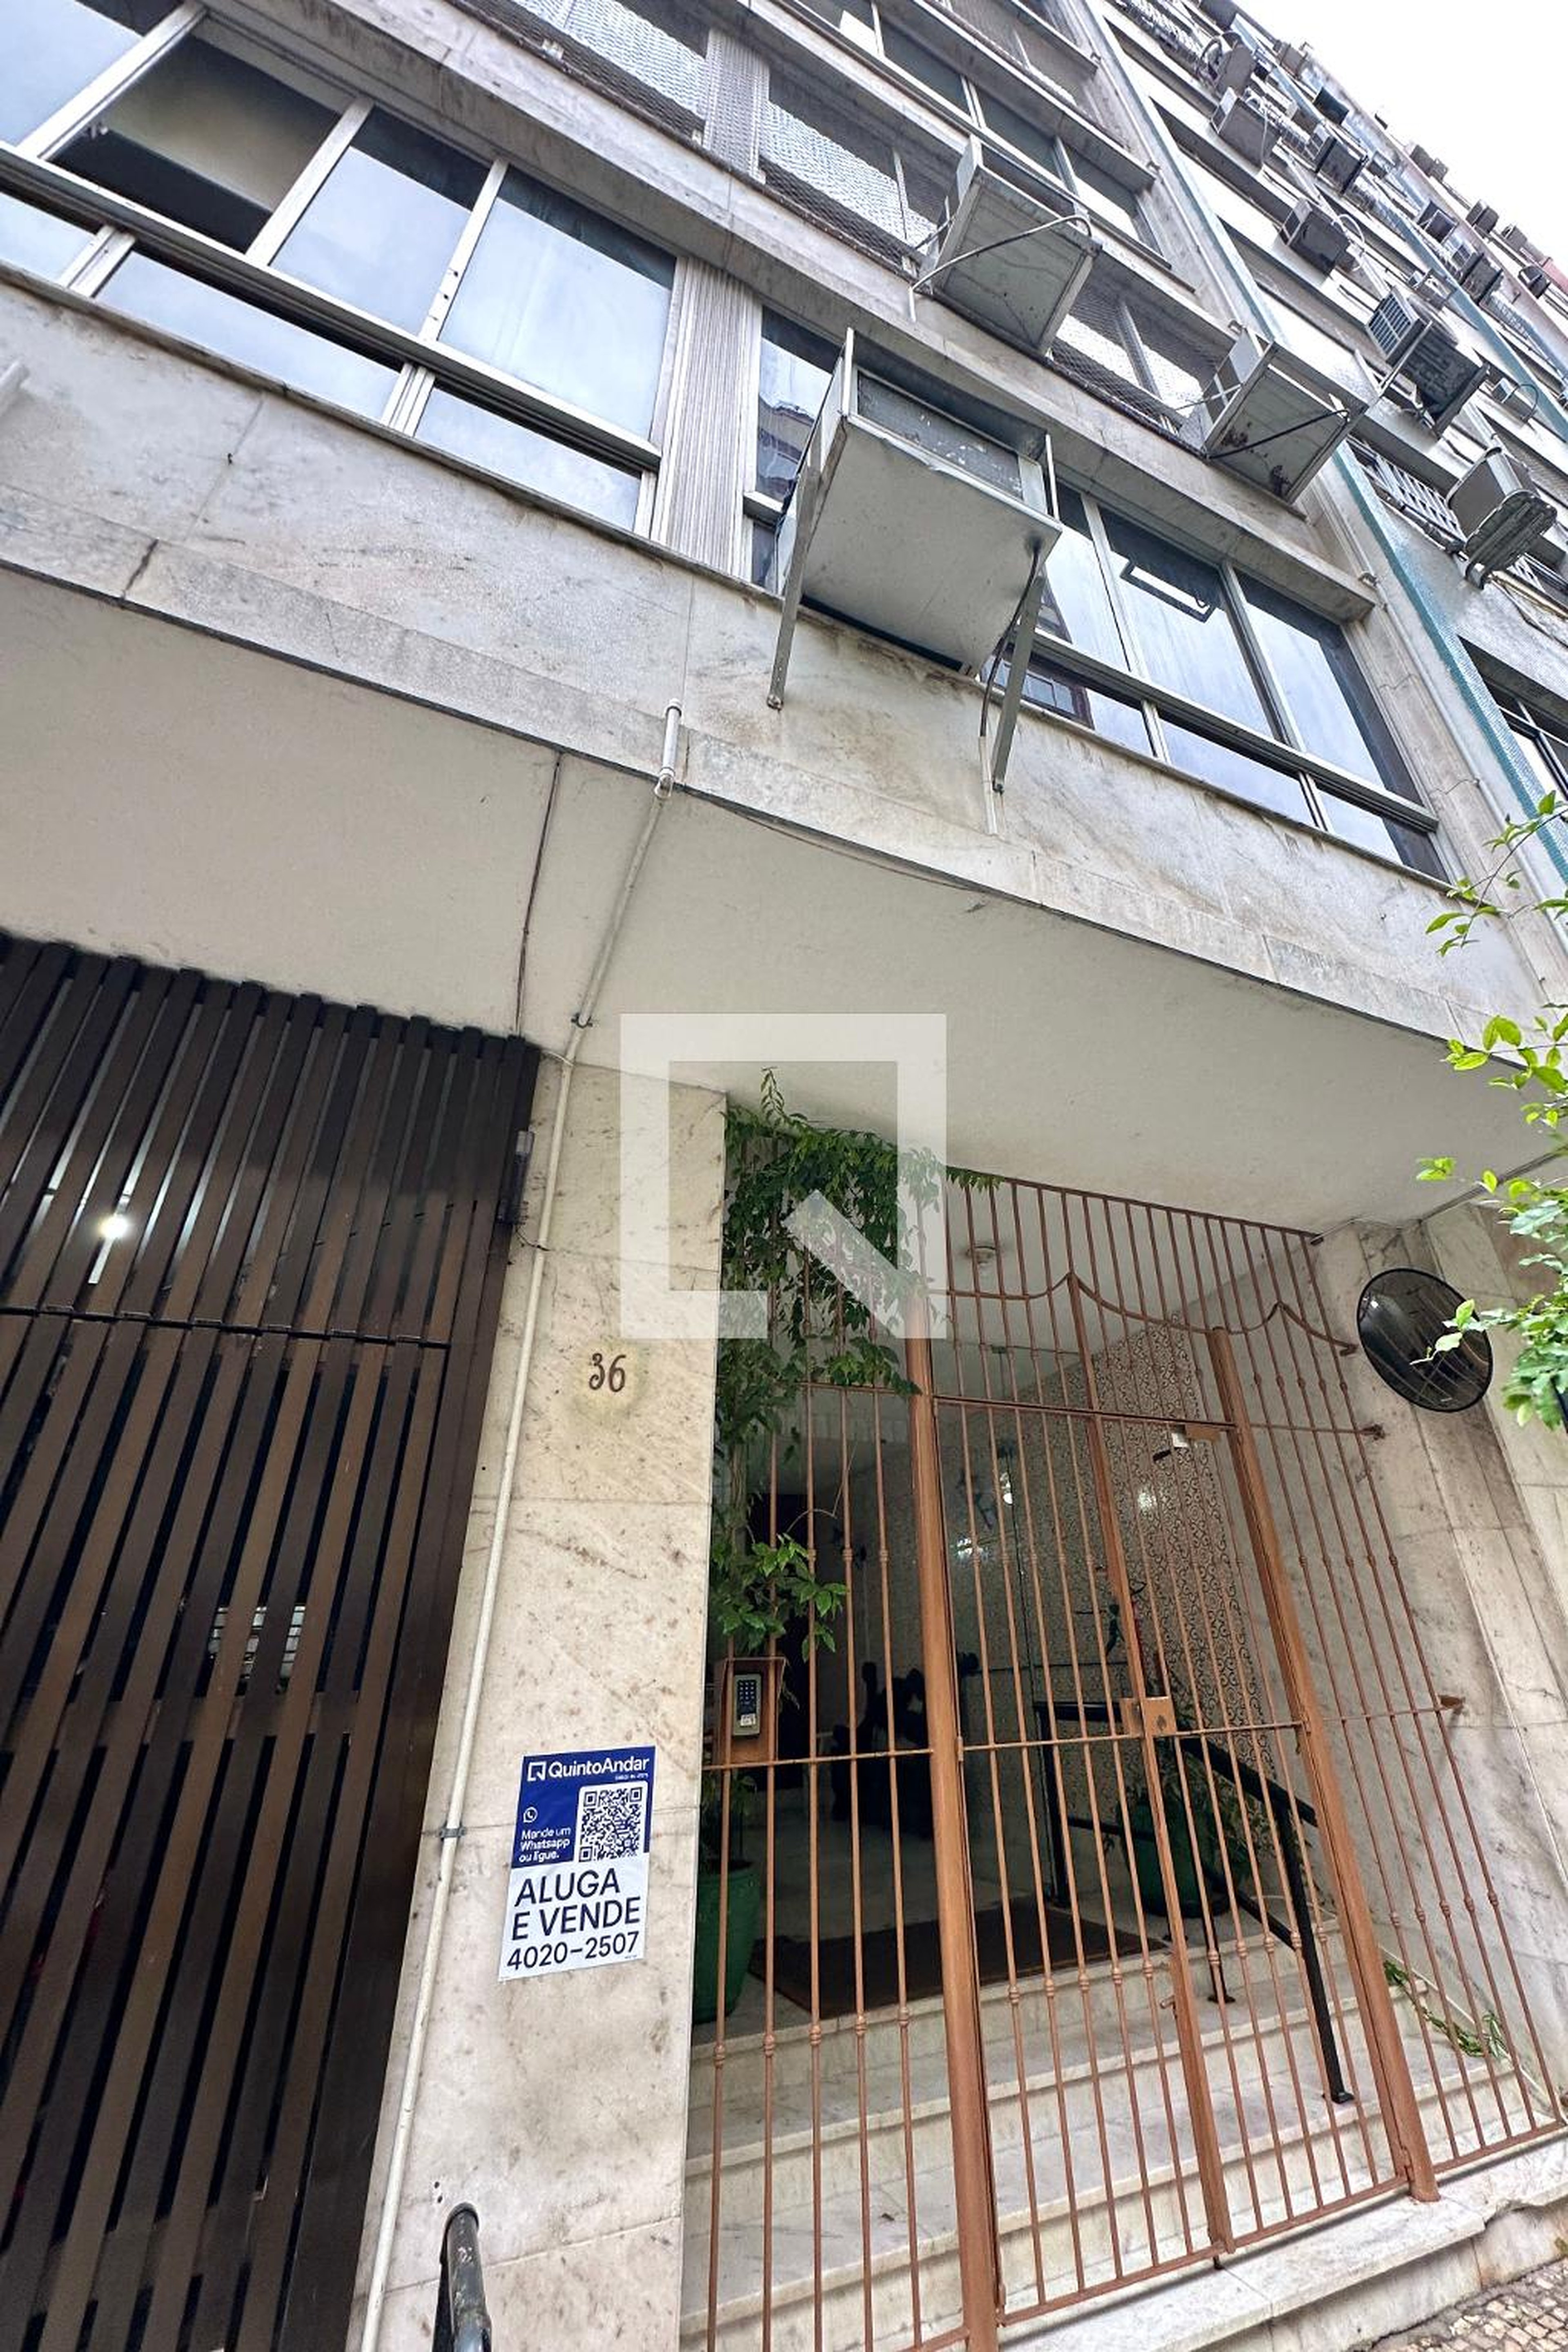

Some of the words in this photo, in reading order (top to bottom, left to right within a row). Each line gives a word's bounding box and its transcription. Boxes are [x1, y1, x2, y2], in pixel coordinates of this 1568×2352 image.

[589, 1353, 626, 1392] 36
[548, 1756, 650, 1778] QuintoAndar
[520, 1838, 570, 1851] Whatsapp
[522, 1827, 555, 1840] Mande
[556, 1827, 571, 1836] um
[519, 1854, 532, 1863] ou
[533, 1851, 559, 1863] ligue.
[514, 1868, 620, 1907] ALUGA
[512, 1911, 530, 1941] E
[539, 1897, 641, 1936] VENDE
[507, 1931, 639, 1970] 4020-2507
